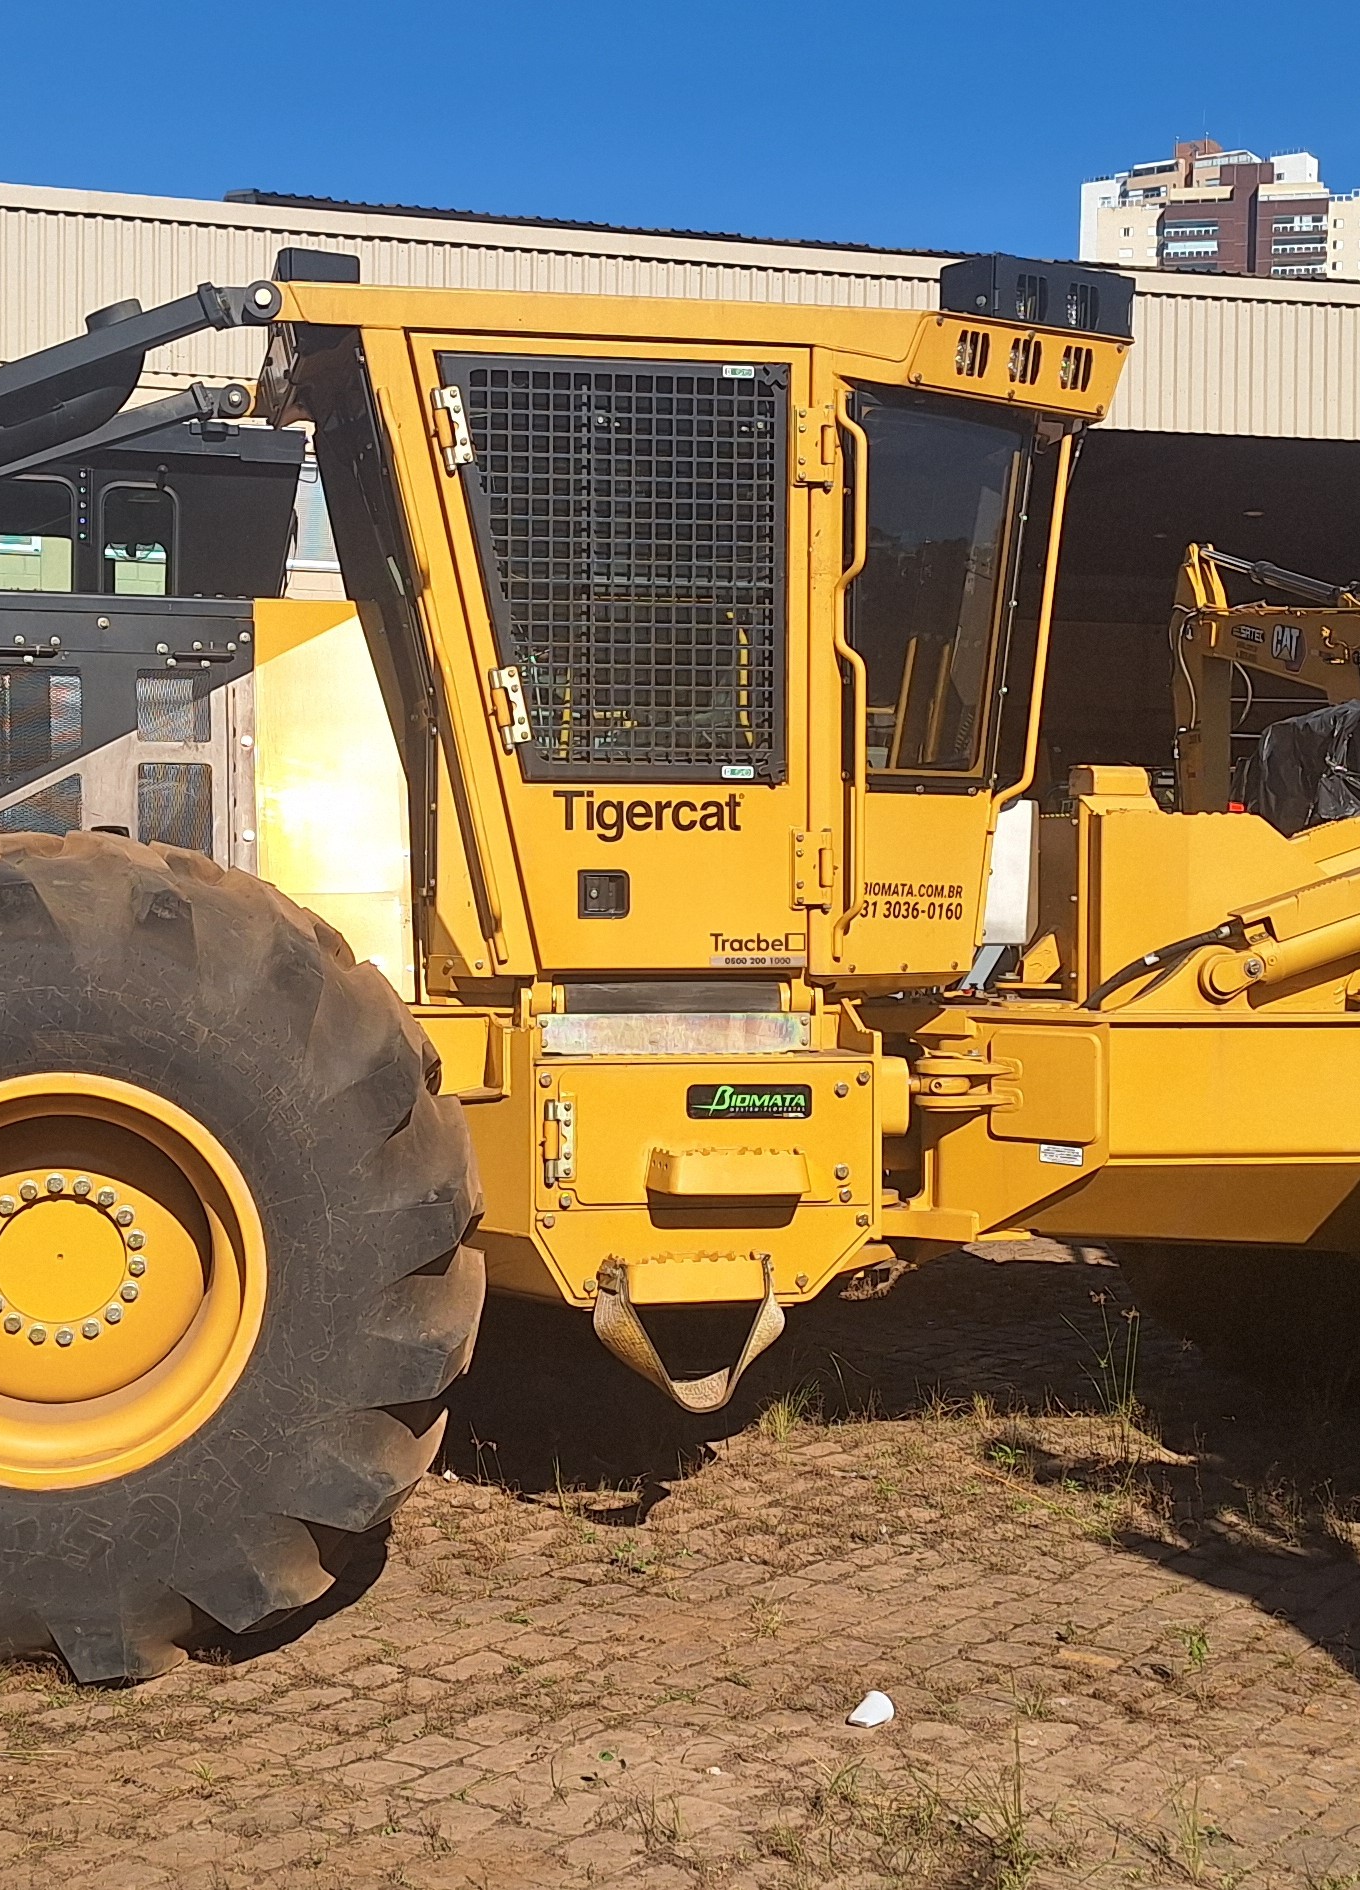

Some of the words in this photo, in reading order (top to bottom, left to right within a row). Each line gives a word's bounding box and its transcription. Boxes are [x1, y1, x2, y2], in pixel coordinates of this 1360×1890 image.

[1272, 624, 1300, 662] CAT
[552, 789, 744, 843] Tigercat
[860, 899, 877, 919] 31
[883, 900, 963, 921] 3036-0160
[709, 932, 806, 952] Tracbel
[690, 1085, 806, 1117] BIOMATA
